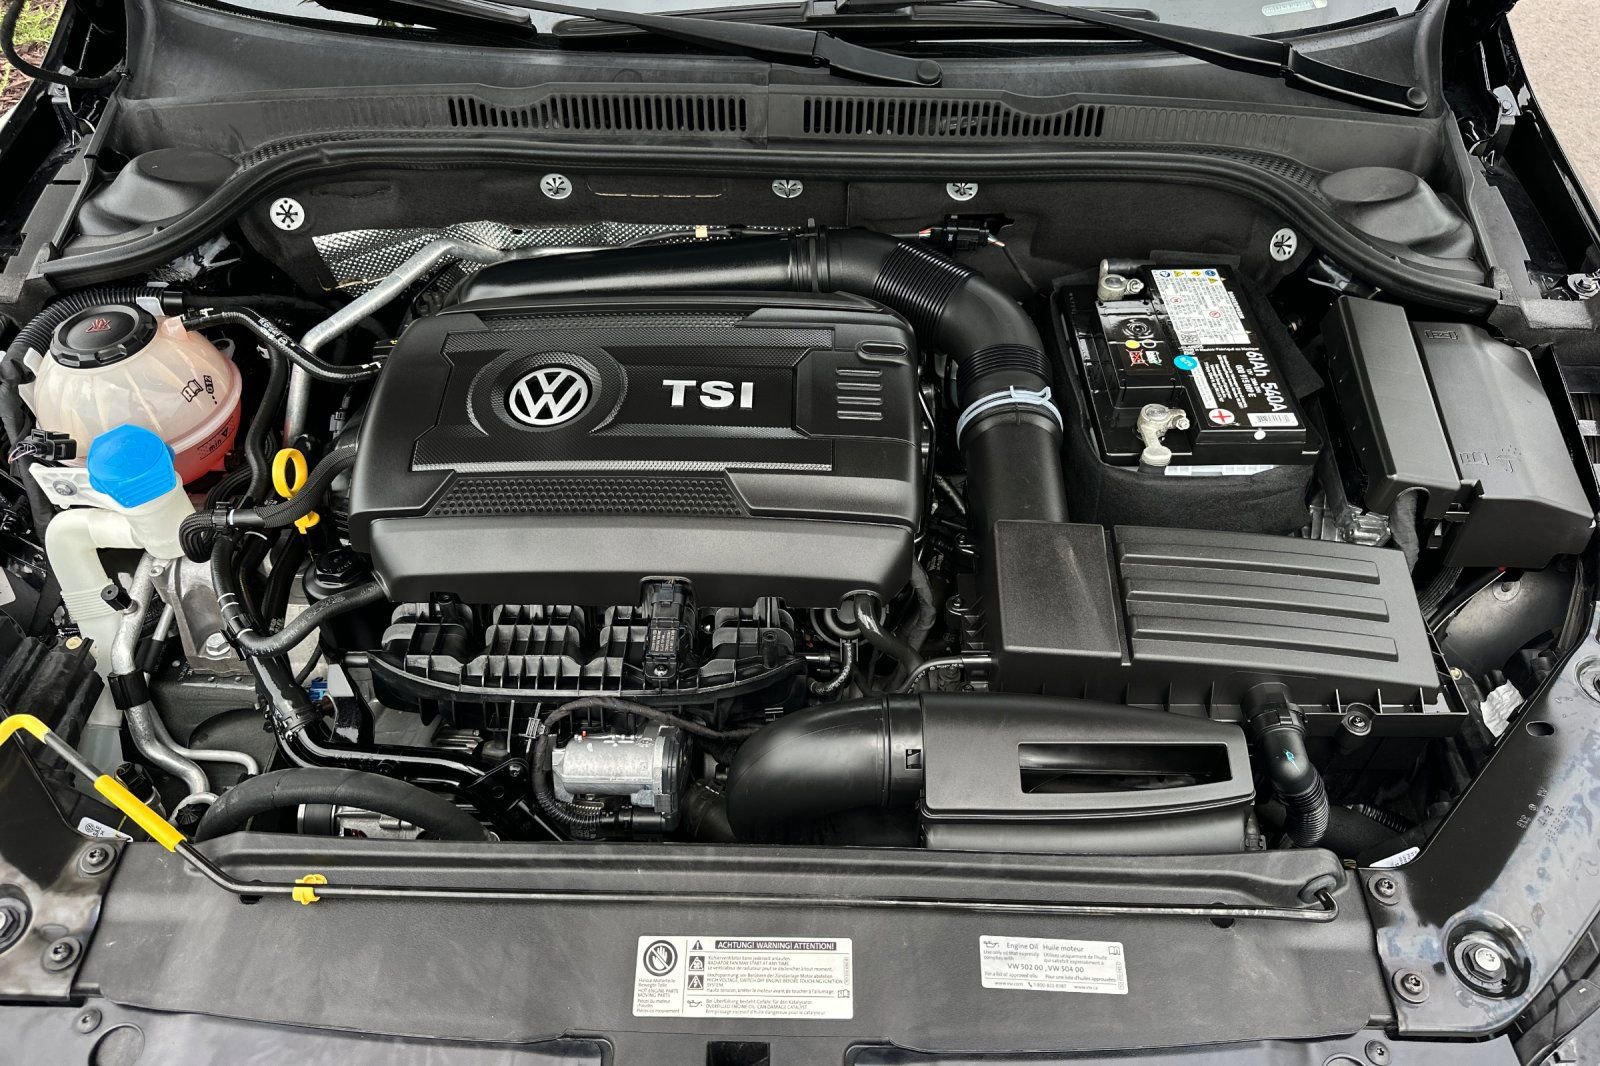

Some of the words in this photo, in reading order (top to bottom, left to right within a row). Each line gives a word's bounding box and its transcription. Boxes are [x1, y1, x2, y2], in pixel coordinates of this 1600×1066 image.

[1246, 352, 1270, 376] 61Ah
[1260, 382, 1288, 412] 540A
[509, 368, 588, 426] VW
[662, 380, 754, 408] TSI
[208, 440, 222, 452] min
[718, 940, 754, 949] ACHTUNG!
[756, 942, 793, 950] WARNING!
[1006, 942, 1028, 950] Engine
